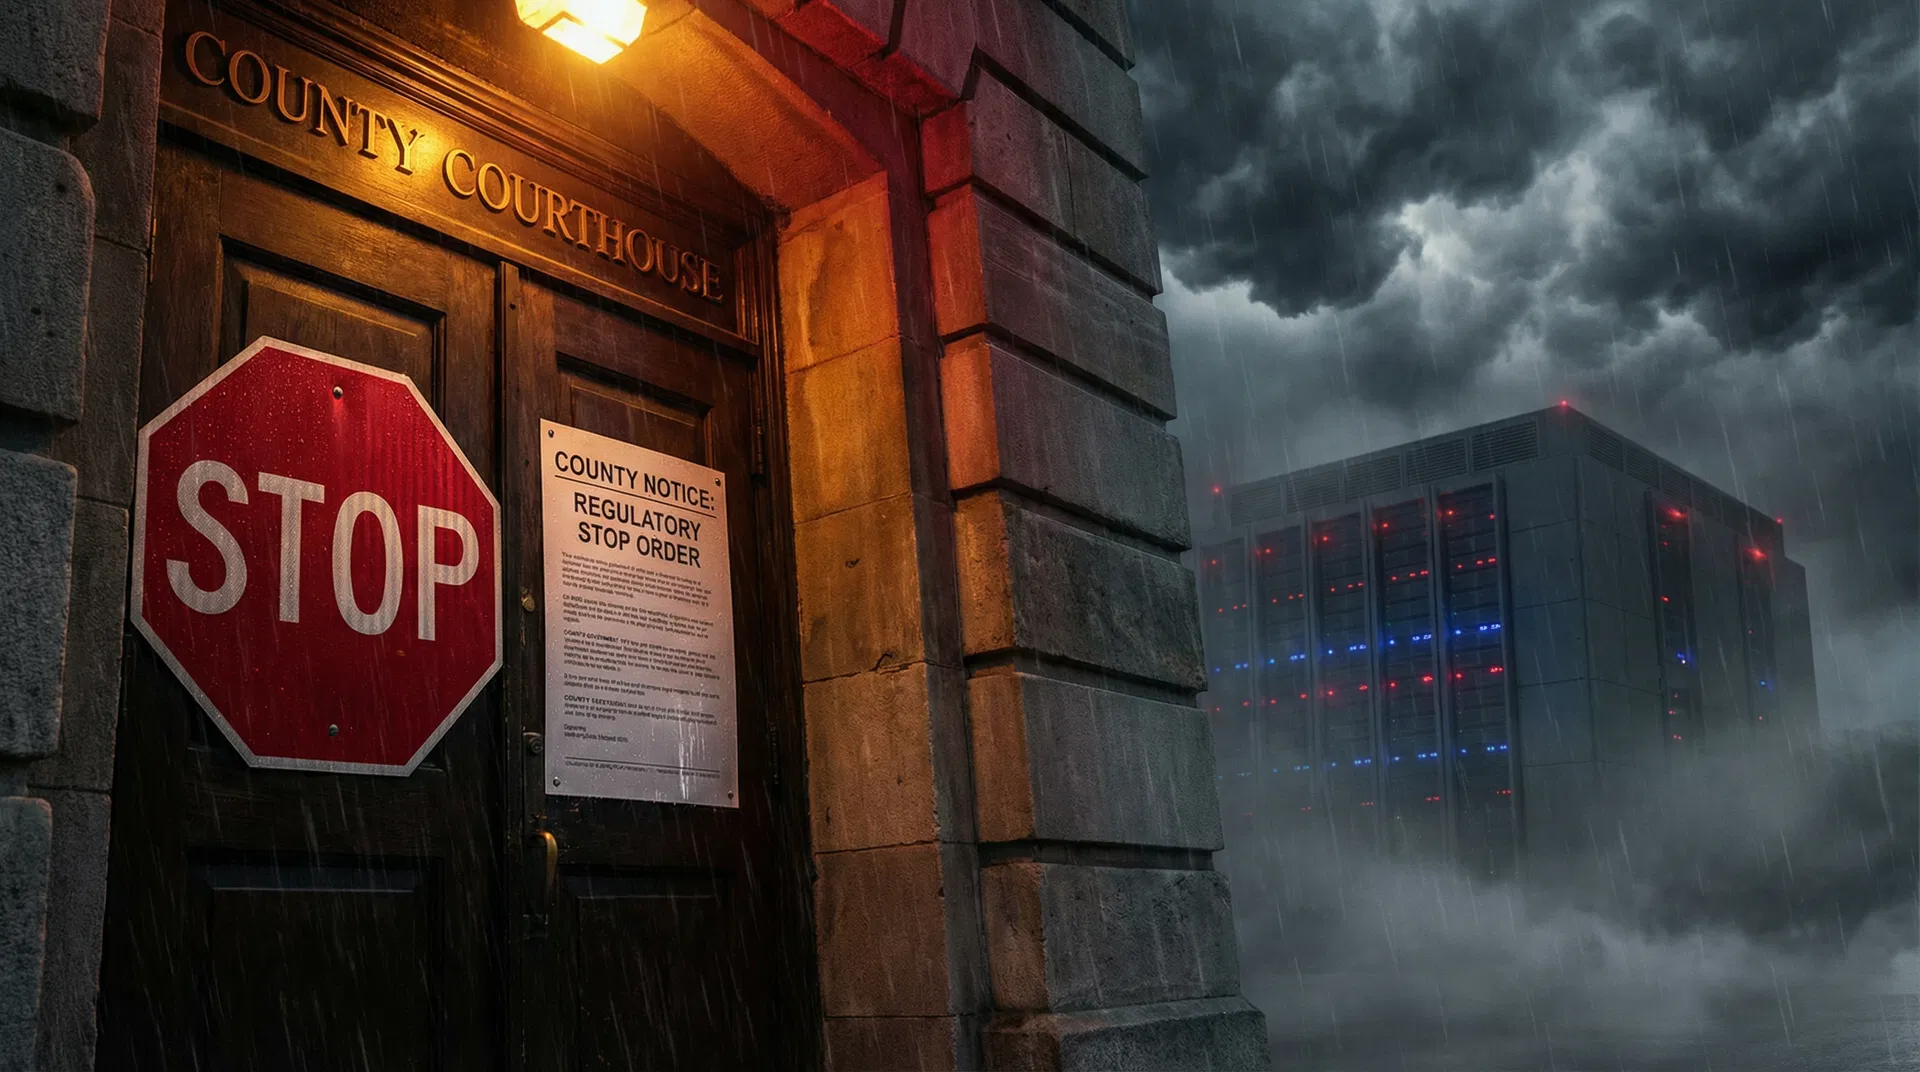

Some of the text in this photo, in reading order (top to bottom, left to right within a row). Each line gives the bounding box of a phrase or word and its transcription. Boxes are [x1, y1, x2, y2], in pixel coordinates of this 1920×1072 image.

[185, 31, 723, 301] COUNTY COURTHOUSE
[555, 451, 715, 511] COUNTY NOTICE:
[574, 492, 701, 541] REGULATORY
[578, 521, 701, 568] STOP ORDER
[166, 460, 479, 641] STOP
